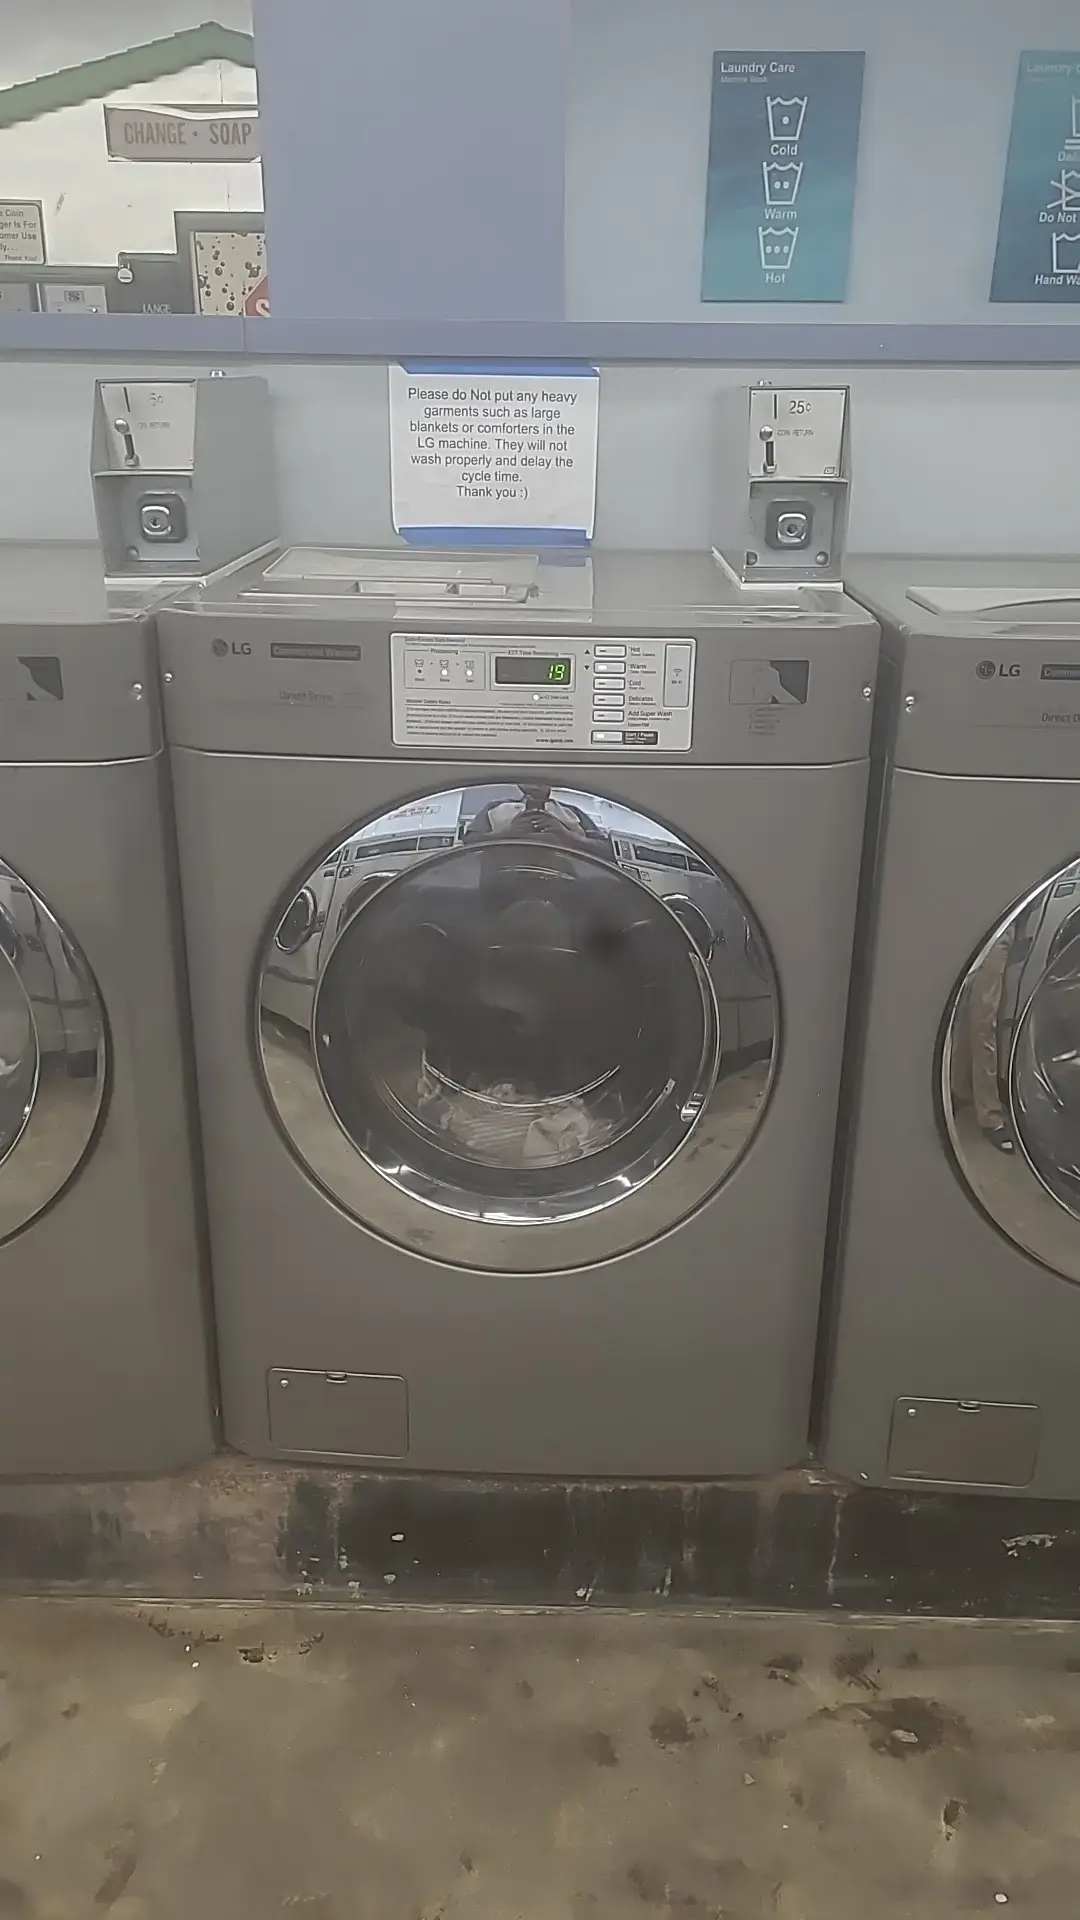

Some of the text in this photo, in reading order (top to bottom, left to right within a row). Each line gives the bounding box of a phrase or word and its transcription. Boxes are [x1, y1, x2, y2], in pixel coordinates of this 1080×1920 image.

[721, 62, 796, 75] Laundry Care
[124, 122, 252, 146] CHANGE SOAP
[770, 144, 798, 155] Cold
[5, 209, 24, 217] Coin
[764, 208, 797, 219] Warm
[1039, 212, 1077, 223] Do Not
[21, 232, 37, 240] Use
[765, 272, 786, 283] Hot
[1034, 274, 1064, 285] Hand
[408, 388, 578, 405] Please do Not put any heavy
[424, 406, 561, 421] garments such as large
[788, 400, 812, 414] 25¢
[410, 421, 575, 435] blankets or comforters in the
[417, 437, 568, 453] LG machine. They will not
[411, 454, 574, 469] wash properly and delay the
[461, 470, 523, 483] cycle time.
[456, 486, 529, 500] Thank you :)
[231, 642, 252, 655] LG
[548, 664, 566, 680] 19
[999, 663, 1021, 677] LG
